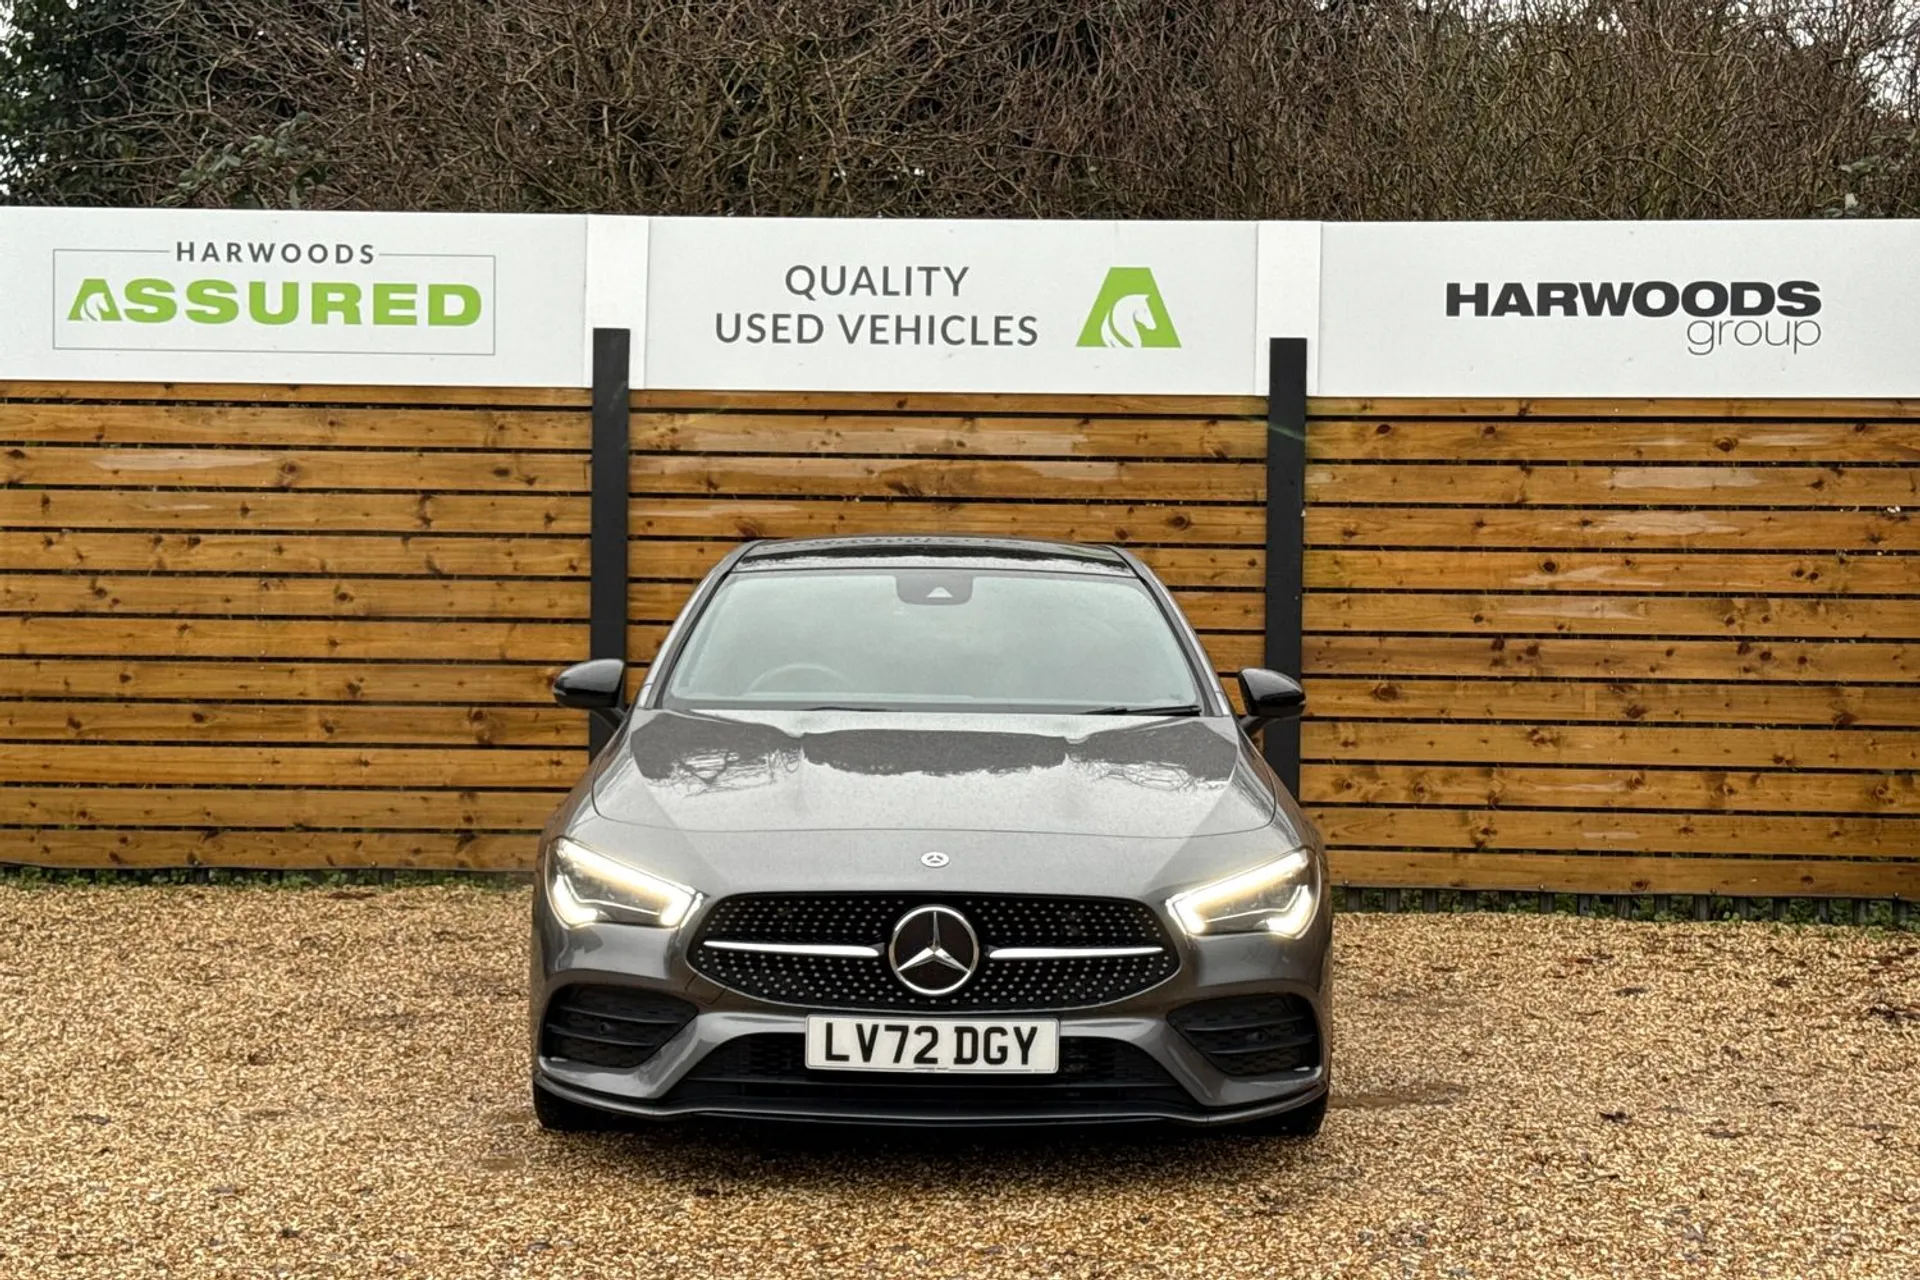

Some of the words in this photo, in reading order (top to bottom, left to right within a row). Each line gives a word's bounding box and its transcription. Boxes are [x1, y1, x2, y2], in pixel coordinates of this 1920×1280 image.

[176, 241, 374, 265] HARWOODS
[785, 265, 970, 301] QUALITY
[1445, 280, 1822, 318] HARWOODS
[68, 278, 482, 326] ASSURED
[716, 313, 824, 345] USED
[837, 315, 1038, 347] VEHICLES
[1686, 319, 1822, 356] group
[825, 1022, 940, 1065] LV72
[953, 1026, 1038, 1066] DGY
